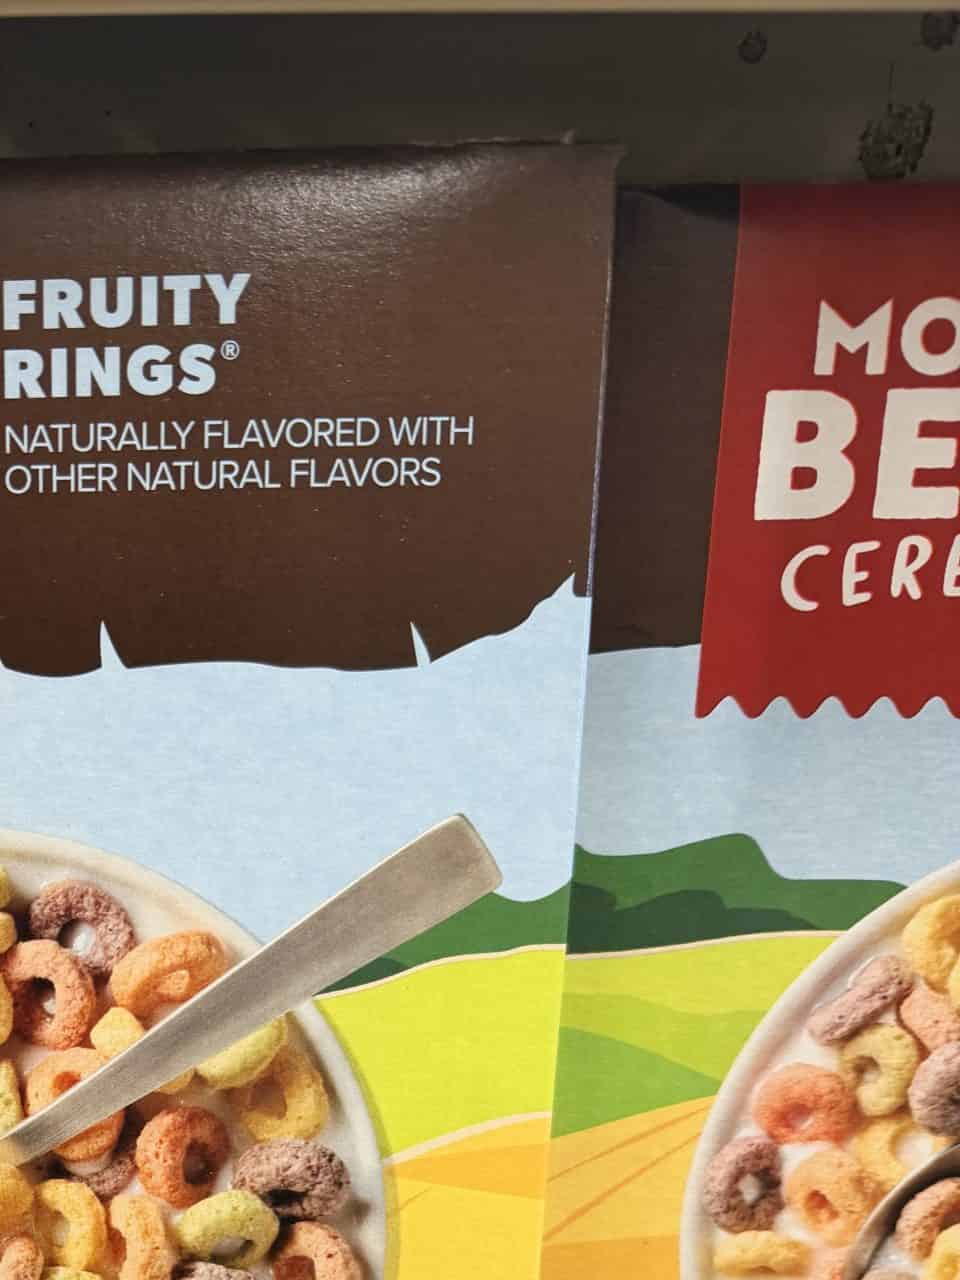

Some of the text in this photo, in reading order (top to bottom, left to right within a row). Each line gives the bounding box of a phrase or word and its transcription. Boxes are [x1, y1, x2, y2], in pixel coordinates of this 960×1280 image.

[2, 273, 252, 331] FRUITY
[4, 414, 475, 455] NATURALLY FLAVORED WITH
[4, 456, 442, 495] OTHER NATURAL FLAVORS
